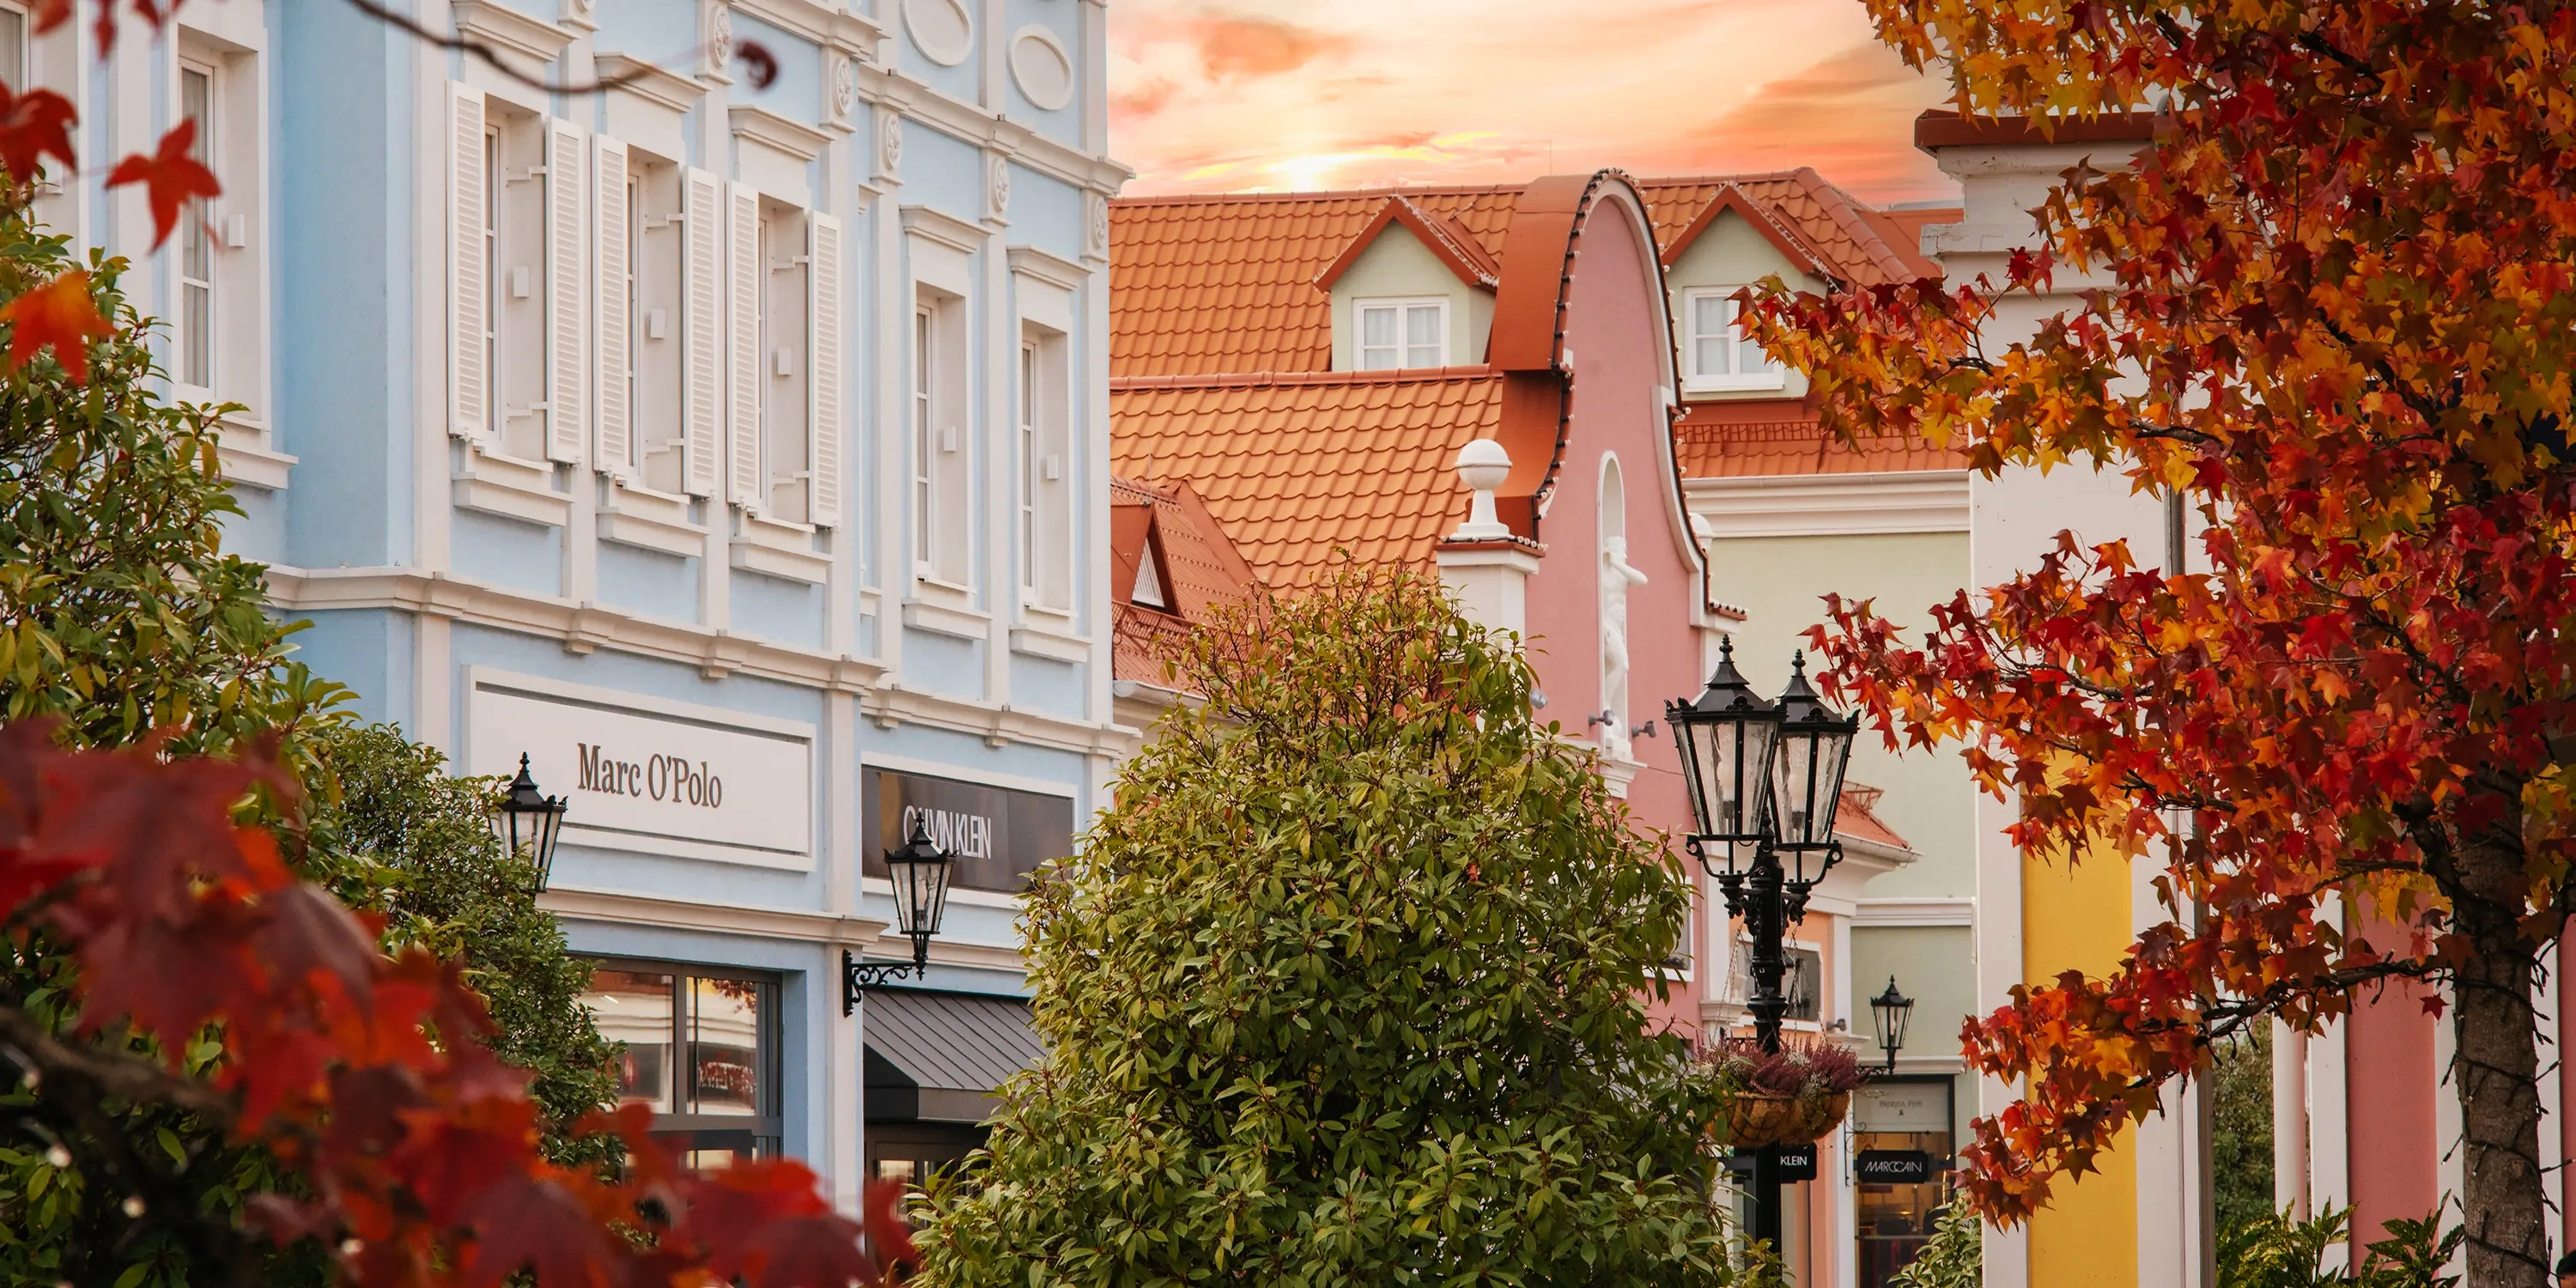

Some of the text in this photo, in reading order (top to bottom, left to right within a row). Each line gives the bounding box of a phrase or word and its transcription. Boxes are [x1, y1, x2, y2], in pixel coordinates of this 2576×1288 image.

[577, 743, 722, 808] Marc O'Polo
[956, 812, 991, 859] KLEIN
[1780, 1156, 1807, 1166] KLEIN
